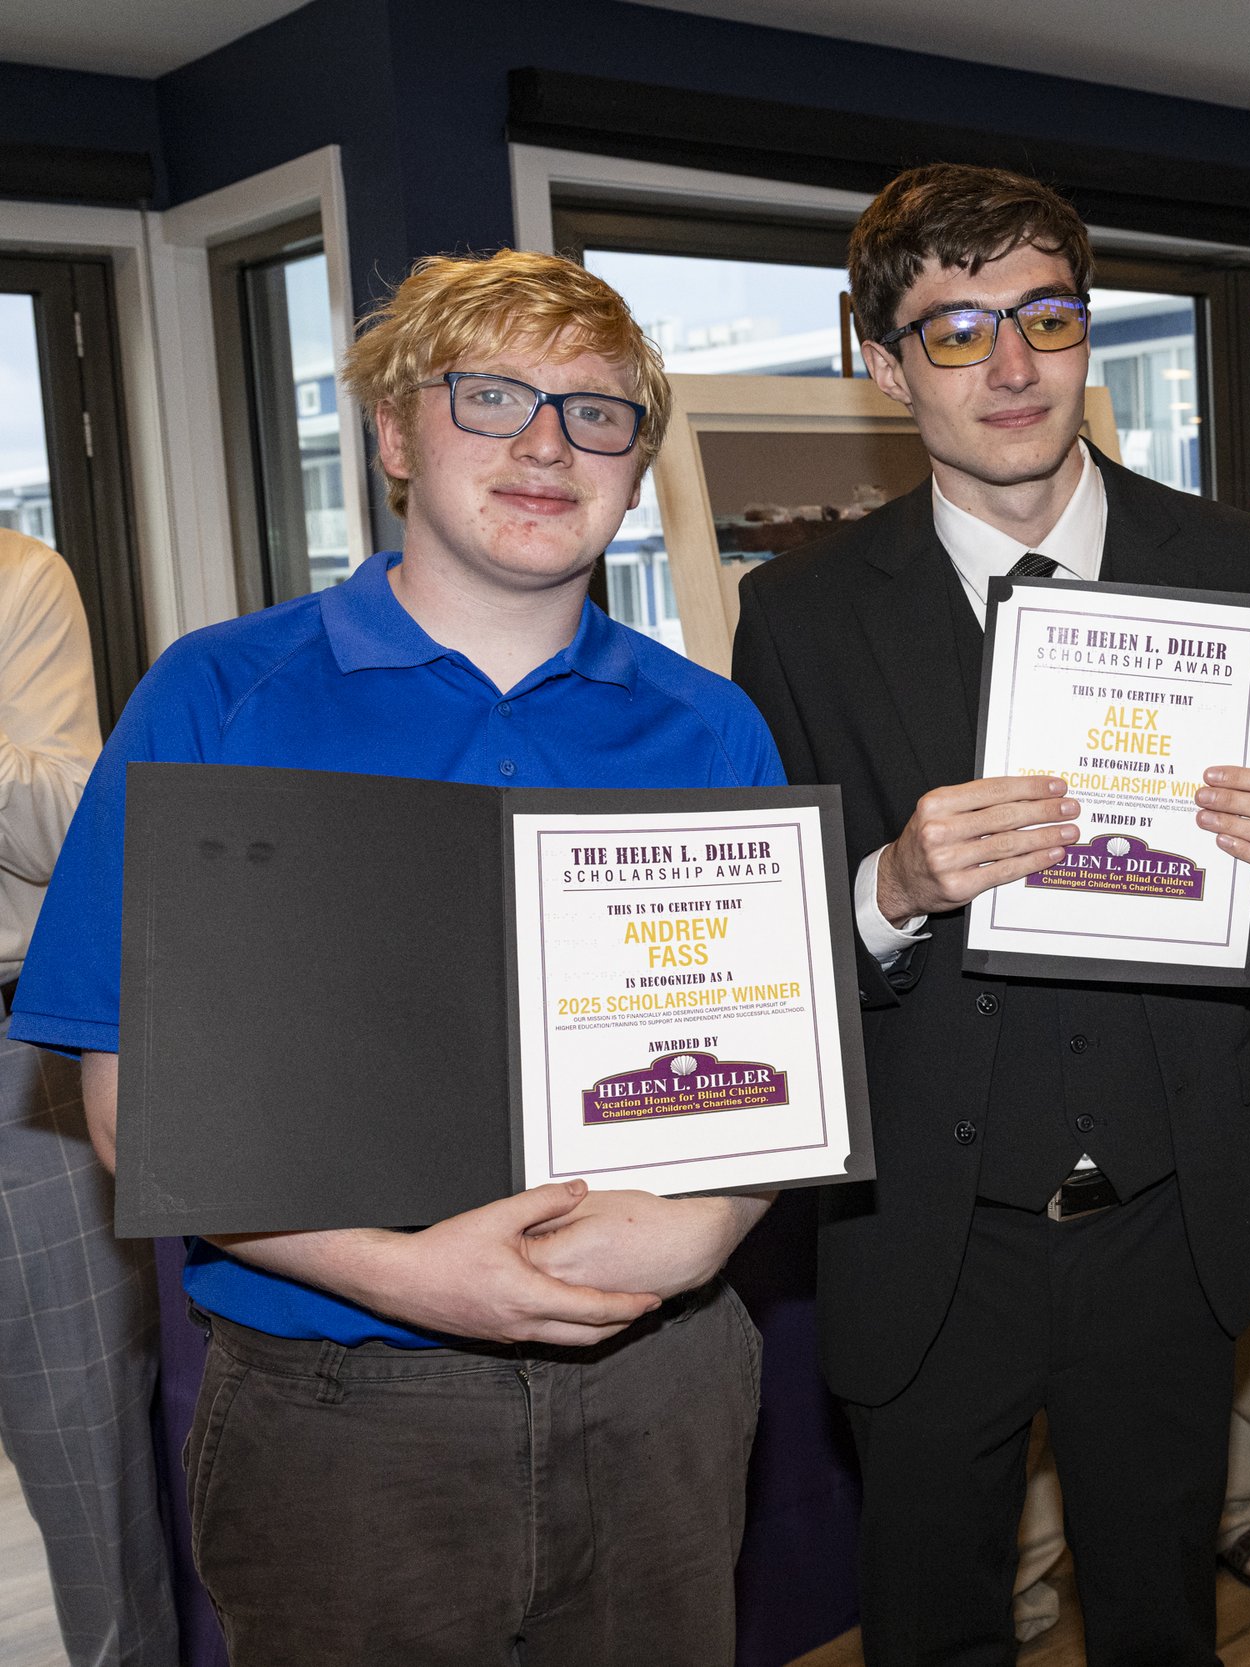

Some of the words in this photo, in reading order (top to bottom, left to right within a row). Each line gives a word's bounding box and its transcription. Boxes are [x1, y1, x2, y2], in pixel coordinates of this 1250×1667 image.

[1046, 625, 1080, 646] THE
[1086, 629, 1139, 652] HELEN
[1144, 635, 1160, 654] L.
[1167, 637, 1227, 660] DILLER
[1037, 647, 1163, 671] SCHOLARSHIP
[1174, 660, 1233, 677] AWARD
[1072, 684, 1095, 697] THIS
[1097, 687, 1107, 698] IS
[1110, 688, 1123, 700] TO
[1127, 690, 1166, 704] CERTIFY
[1169, 694, 1194, 706] THAT
[1103, 705, 1159, 731] ALEX
[1086, 728, 1172, 757] SCHNEE
[1079, 756, 1088, 767] IS
[1091, 757, 1150, 773] RECOGNIZED
[1153, 763, 1165, 774] AS
[1168, 764, 1174, 775] A
[1090, 812, 1137, 826] AWARDED
[1139, 816, 1153, 828] BY
[571, 847, 608, 866] THE
[615, 845, 673, 865] HELEN
[681, 845, 697, 863] L.
[705, 841, 771, 862] DILLER
[563, 866, 703, 883] SCHOLARSHIP
[716, 862, 780, 878] AWARD
[1039, 868, 1076, 877] acation
[1079, 870, 1108, 880] Home
[1109, 872, 1124, 881] for
[1125, 873, 1151, 884] Blind
[1153, 875, 1194, 887] Children
[1106, 856, 1121, 871] L.
[1126, 858, 1191, 877] DILLER
[1042, 876, 1086, 888] Challenged
[1087, 880, 1127, 890] Children's
[1128, 883, 1164, 893] Charities
[1165, 886, 1186, 896] Corp.
[606, 904, 632, 916] THIS
[636, 903, 646, 915] IS
[649, 903, 664, 914] TO
[668, 900, 712, 913] CERTIFY
[715, 898, 743, 910] THAT
[624, 916, 729, 945] ANDREW
[648, 943, 709, 969] FASS
[625, 977, 636, 989] IS
[640, 973, 706, 988] RECOGNIZED
[710, 971, 723, 983] AS
[726, 971, 733, 982] A
[558, 997, 602, 1016] 2025
[607, 988, 728, 1013] SCHOLARSHIP
[732, 981, 801, 1003] WINNER
[672, 1008, 704, 1016] DESERVING
[648, 1038, 700, 1053] AWARDED
[704, 1036, 718, 1048] BY
[598, 1078, 667, 1099] HELEN
[673, 1077, 691, 1092] L.
[695, 1069, 771, 1089] DILLER
[594, 1098, 641, 1110] Vacation
[644, 1096, 676, 1105] Home
[679, 1093, 695, 1102] for
[697, 1089, 726, 1100] Blind
[729, 1085, 776, 1097] Children
[602, 1106, 653, 1119] Challenged
[655, 1102, 701, 1113] Children's
[702, 1098, 743, 1108] Charities
[745, 1096, 767, 1104] Corp.
